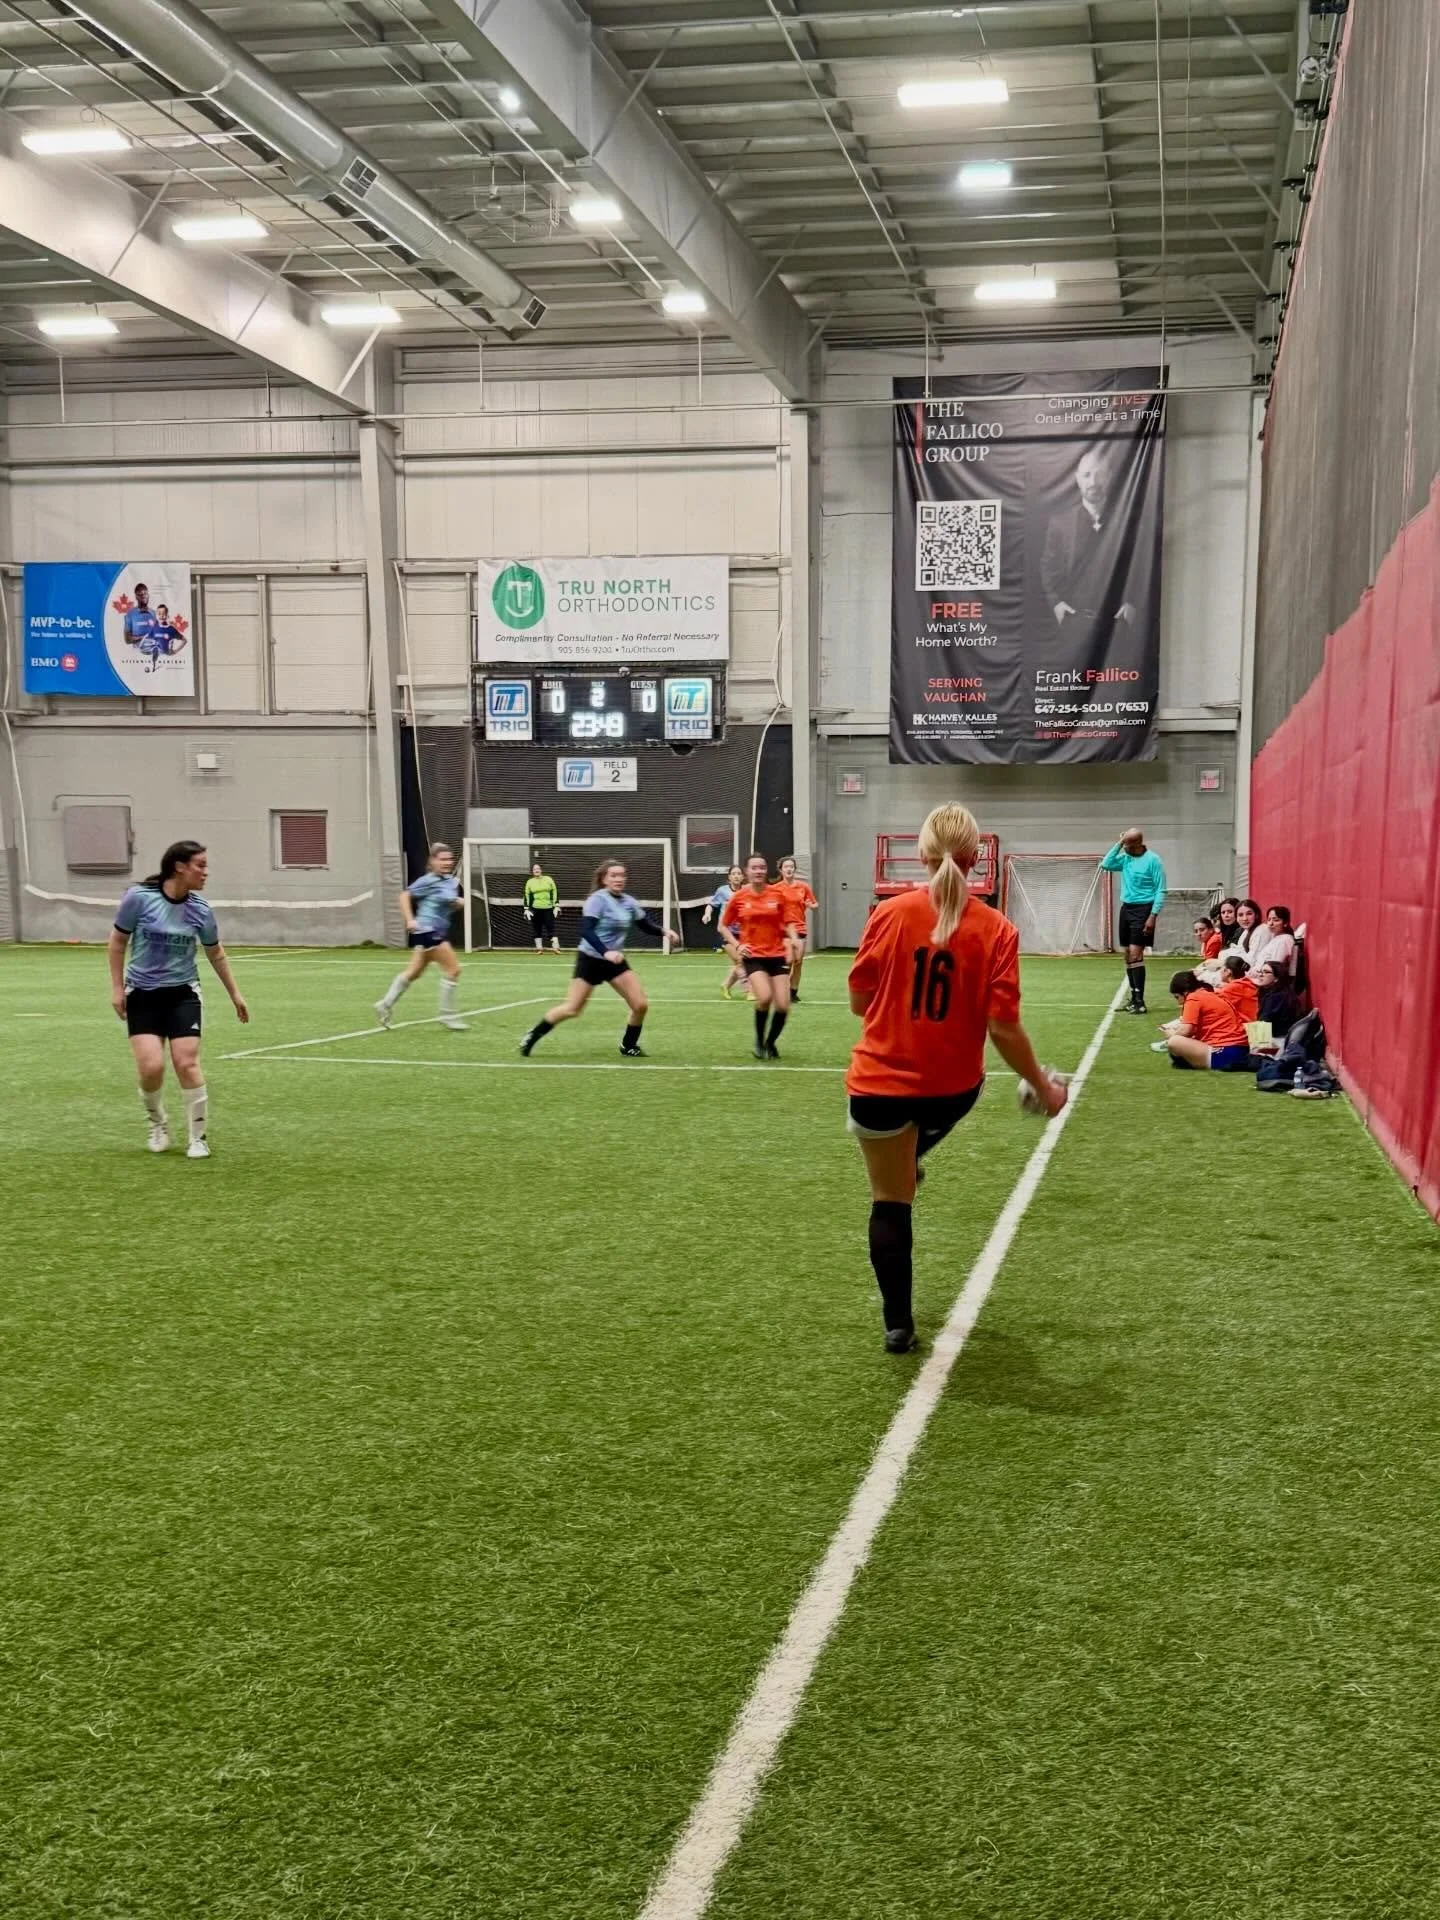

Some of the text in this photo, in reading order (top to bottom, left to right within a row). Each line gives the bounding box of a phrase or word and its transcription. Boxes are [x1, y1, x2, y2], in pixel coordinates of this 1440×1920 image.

[1048, 395, 1149, 410] Changing LIVES
[926, 402, 964, 418] THE
[1035, 409, 1160, 423] One Home at a Time
[926, 422, 1003, 440] FALLICO
[926, 446, 989, 462] GROUP
[558, 579, 671, 595] TRU NORTH
[558, 596, 715, 612] ORTHODONTICS
[931, 602, 983, 618] FREE
[31, 616, 95, 628] MVP-to-be.
[927, 622, 987, 634] What's My
[557, 633, 613, 642] Consultation
[636, 632, 671, 641] Referral
[674, 632, 720, 642] Necessary
[915, 636, 997, 647] Home Worth?
[31, 657, 59, 667] BMO
[1036, 668, 1139, 684] Frank Fallico
[928, 678, 983, 688] SERVING
[590, 687, 605, 708] 2
[924, 692, 986, 703] VAUGHAN
[1035, 702, 1149, 714] 647-254-SOLD (7653)
[928, 713, 963, 722] HARVEY
[965, 713, 998, 721] KALLES
[489, 720, 529, 731] TRIO
[667, 720, 709, 730] TRIO
[603, 761, 628, 769] FIELD
[611, 769, 621, 783] 2
[911, 946, 955, 1023] 16
